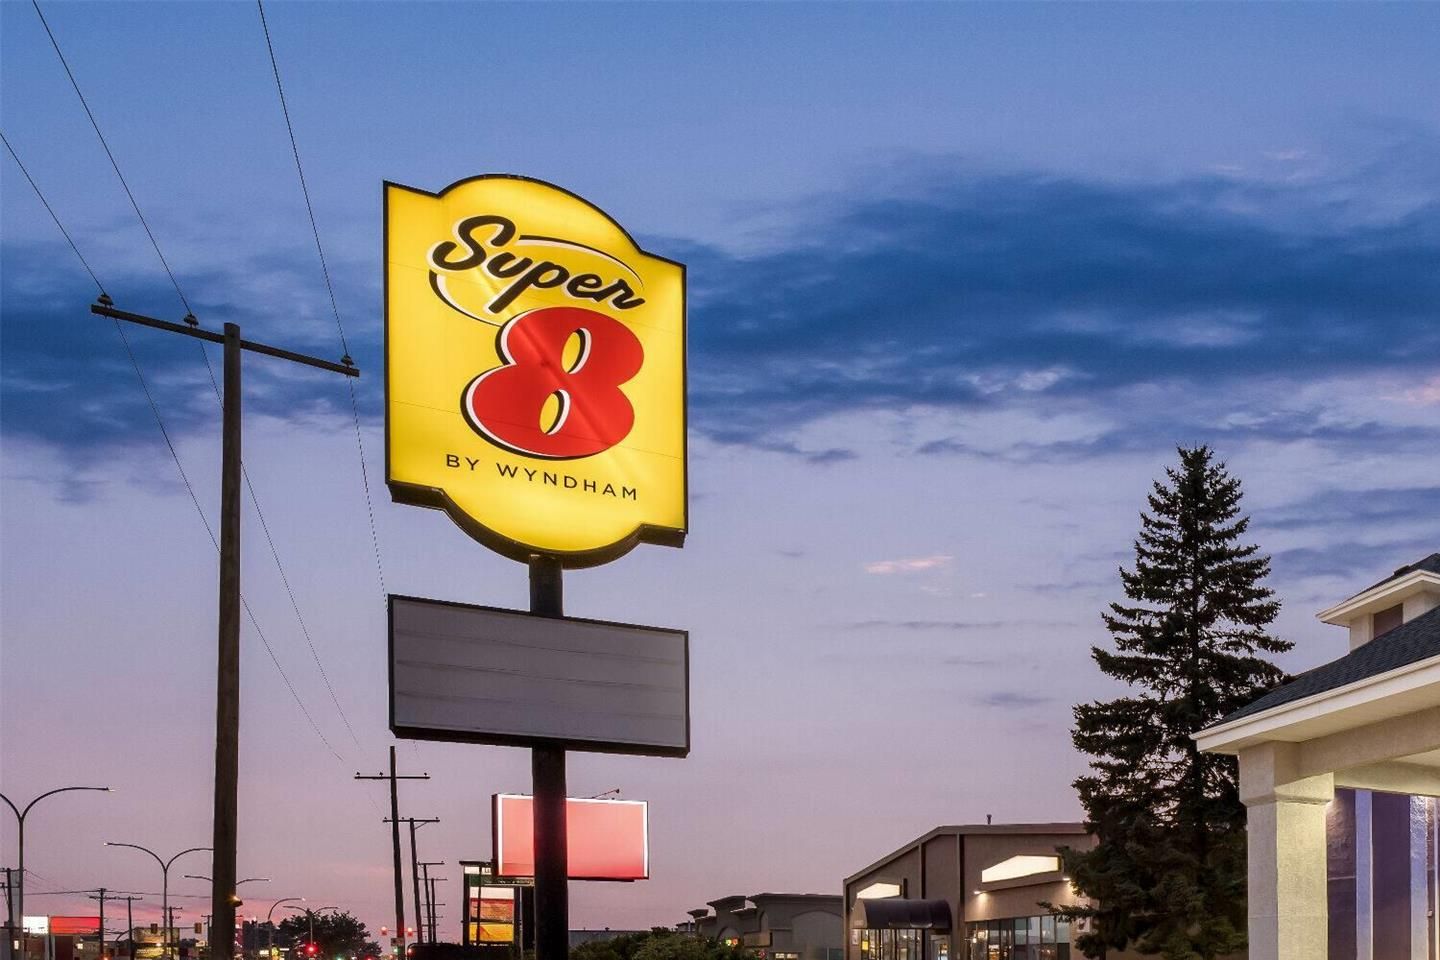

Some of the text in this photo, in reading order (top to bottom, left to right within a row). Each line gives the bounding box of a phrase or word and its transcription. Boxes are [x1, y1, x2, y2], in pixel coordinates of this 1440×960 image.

[431, 214, 646, 314] Super
[460, 306, 644, 460] 8
[446, 454, 637, 500] BY WYNDHAM
